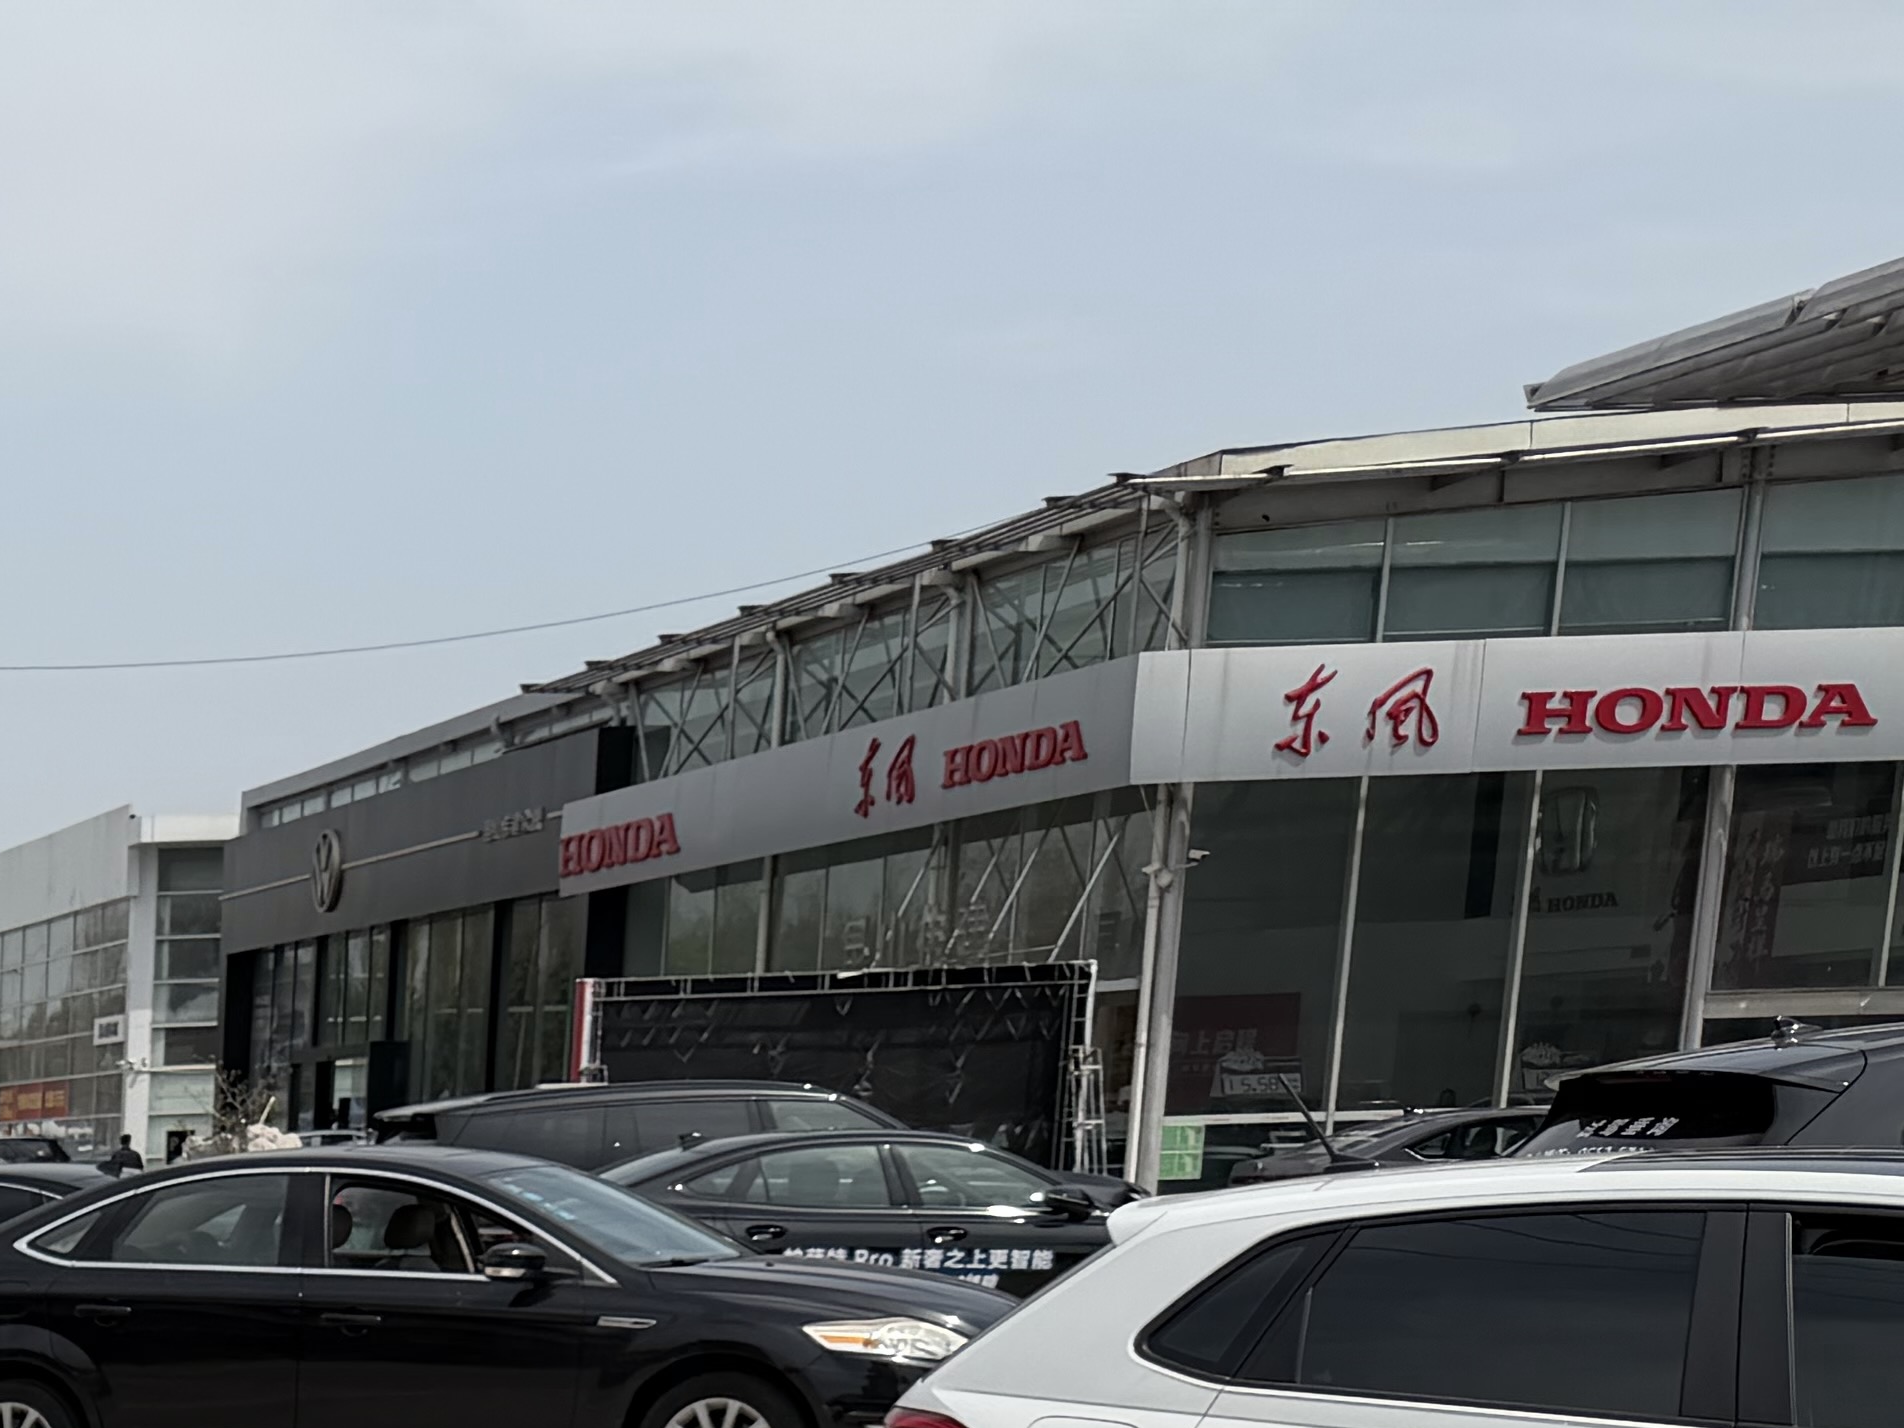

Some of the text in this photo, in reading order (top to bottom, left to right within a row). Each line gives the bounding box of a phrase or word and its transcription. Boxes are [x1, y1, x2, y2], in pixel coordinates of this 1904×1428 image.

[1517, 682, 1879, 737] HONDA
[941, 719, 1089, 790] HONDA
[559, 811, 682, 879] HONDA
[1547, 891, 1620, 913] HONDA
